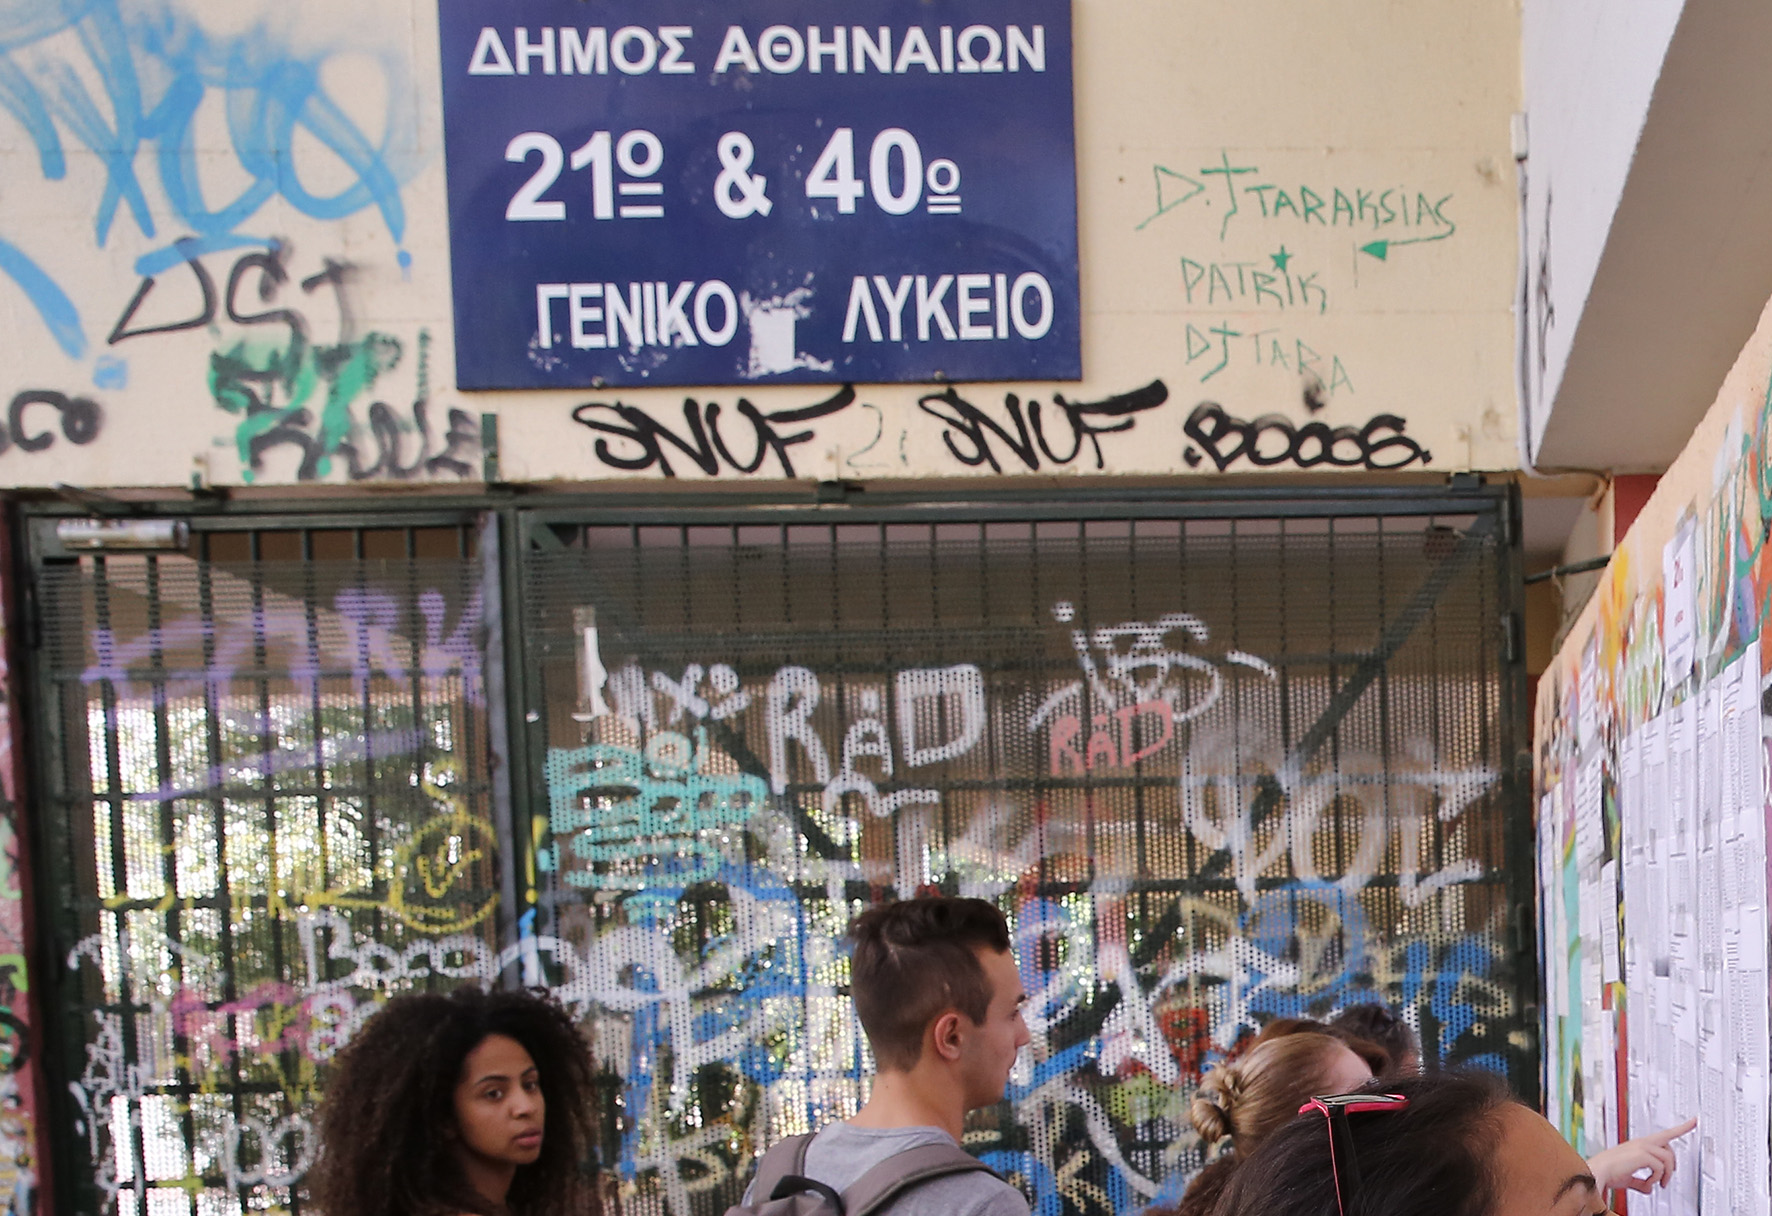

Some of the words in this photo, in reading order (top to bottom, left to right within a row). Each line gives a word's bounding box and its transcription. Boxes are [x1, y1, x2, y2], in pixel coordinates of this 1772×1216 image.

[467, 26, 694, 75] ΔΗΜΟΣ
[714, 25, 1046, 73] ΑΘΗΝΑΙΩΝ
[714, 132, 773, 219] &
[536, 280, 739, 350] ΓΕΝΙΚΟ
[843, 273, 1054, 343] ΛΥΚΕΙΟ
